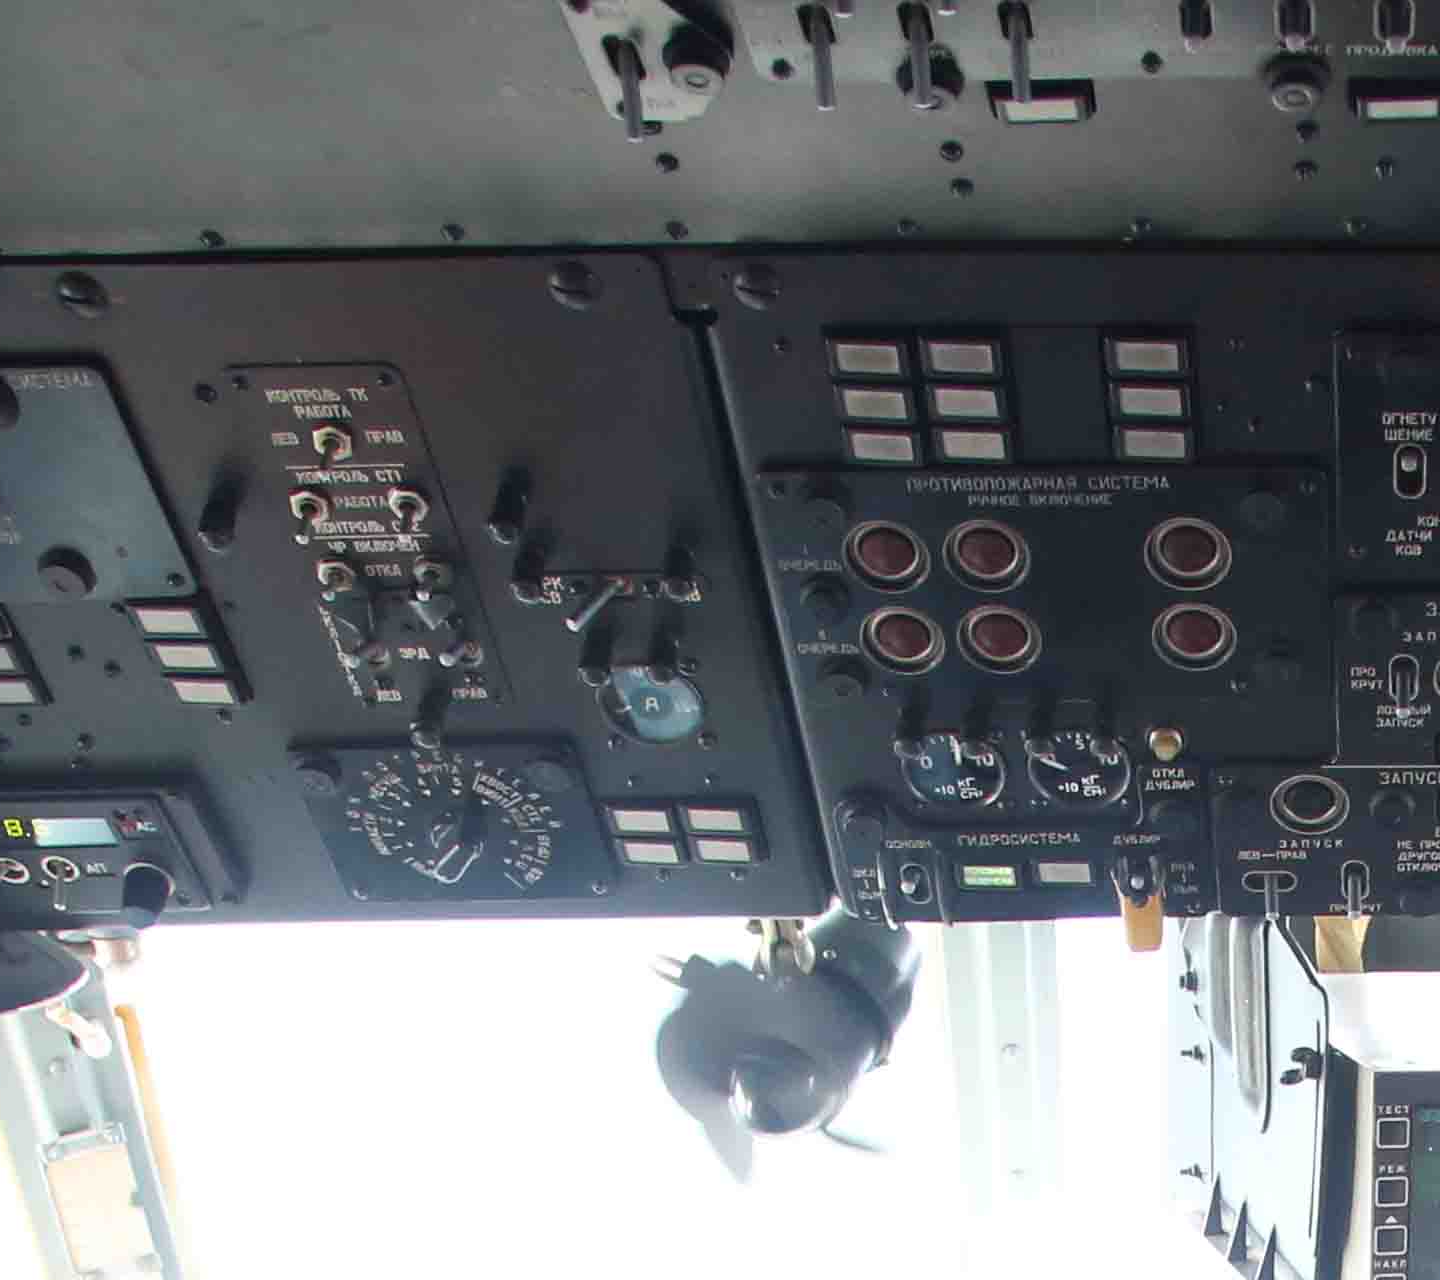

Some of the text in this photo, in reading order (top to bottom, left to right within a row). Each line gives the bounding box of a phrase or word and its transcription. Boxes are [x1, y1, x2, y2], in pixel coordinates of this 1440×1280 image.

[294, 405, 352, 419] РАБОТА
[1383, 427, 1434, 441] ШЕНИЕ
[906, 474, 1172, 492] ПРОТИВОПОЖАРНАЯ СИСТЕМА
[1384, 530, 1434, 544] ДАТЧИ
[1393, 545, 1423, 558] КОВ
[1350, 666, 1377, 679] ПРО
[1350, 679, 1384, 691] КРУТ
[1375, 718, 1426, 730] ЗАПУСК
[957, 833, 1082, 848] ГИДРОСИСТЕМА
[1279, 838, 1345, 850] ЗАПУСК
[1396, 839, 1414, 851] НЕ
